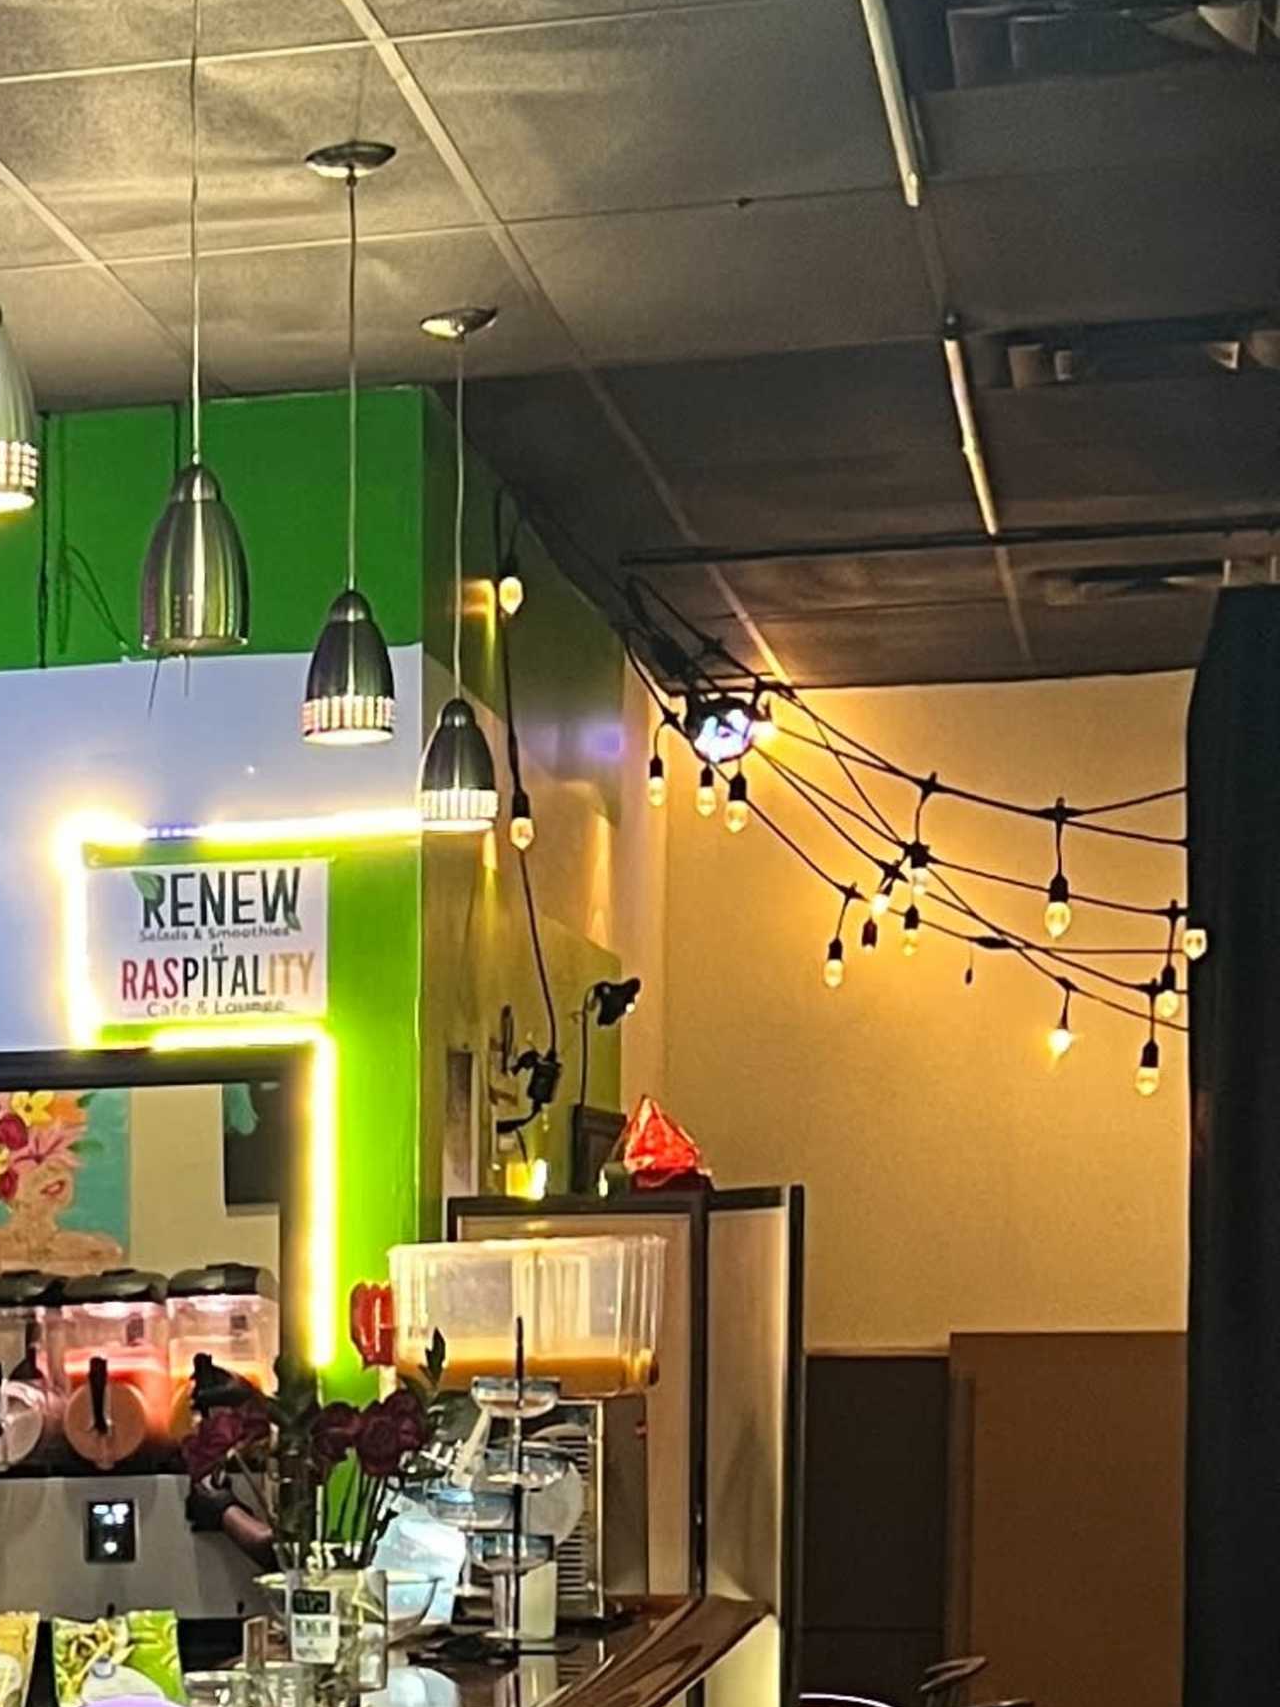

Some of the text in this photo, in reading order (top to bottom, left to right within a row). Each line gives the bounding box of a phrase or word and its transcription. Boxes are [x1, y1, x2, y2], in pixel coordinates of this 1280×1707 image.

[133, 867, 301, 930] RENEW
[140, 926, 290, 943] Salads & Smoothies
[211, 941, 225, 955] at
[121, 952, 316, 1001] RASPITALITY
[196, 999, 208, 1015] &
